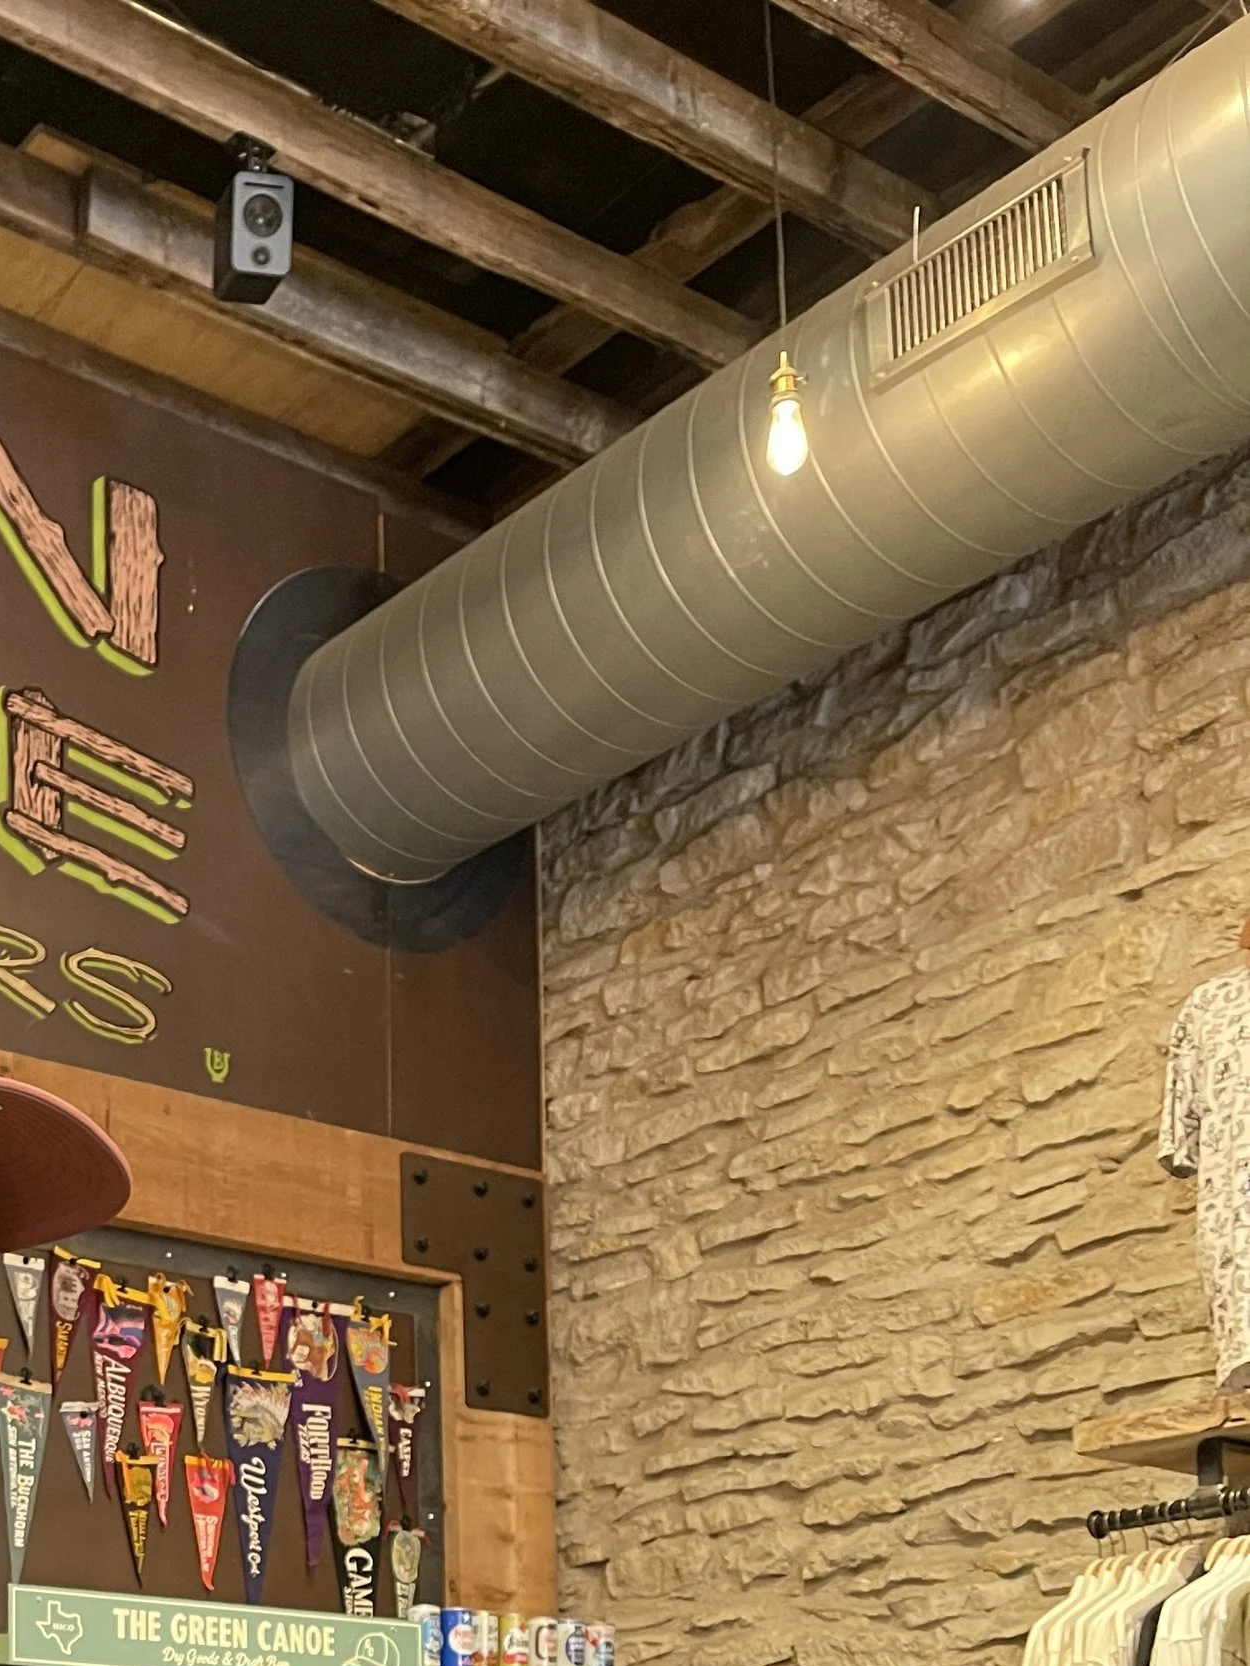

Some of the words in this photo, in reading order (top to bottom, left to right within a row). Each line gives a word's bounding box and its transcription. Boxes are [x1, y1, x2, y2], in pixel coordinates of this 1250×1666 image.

[102, 1354, 131, 1463] ALBUQUERQUE
[301, 1403, 332, 1459] FORT
[17, 1438, 37, 1470] THE
[80, 1429, 92, 1449] SAN
[14, 1473, 36, 1548] BUCKHORN
[240, 1456, 268, 1552] Westport
[112, 1608, 162, 1642] THE
[170, 1613, 248, 1650] GREEN
[257, 1620, 336, 1657] CANOE
[162, 1646, 186, 1666] Dry
[222, 1651, 234, 1666] &
